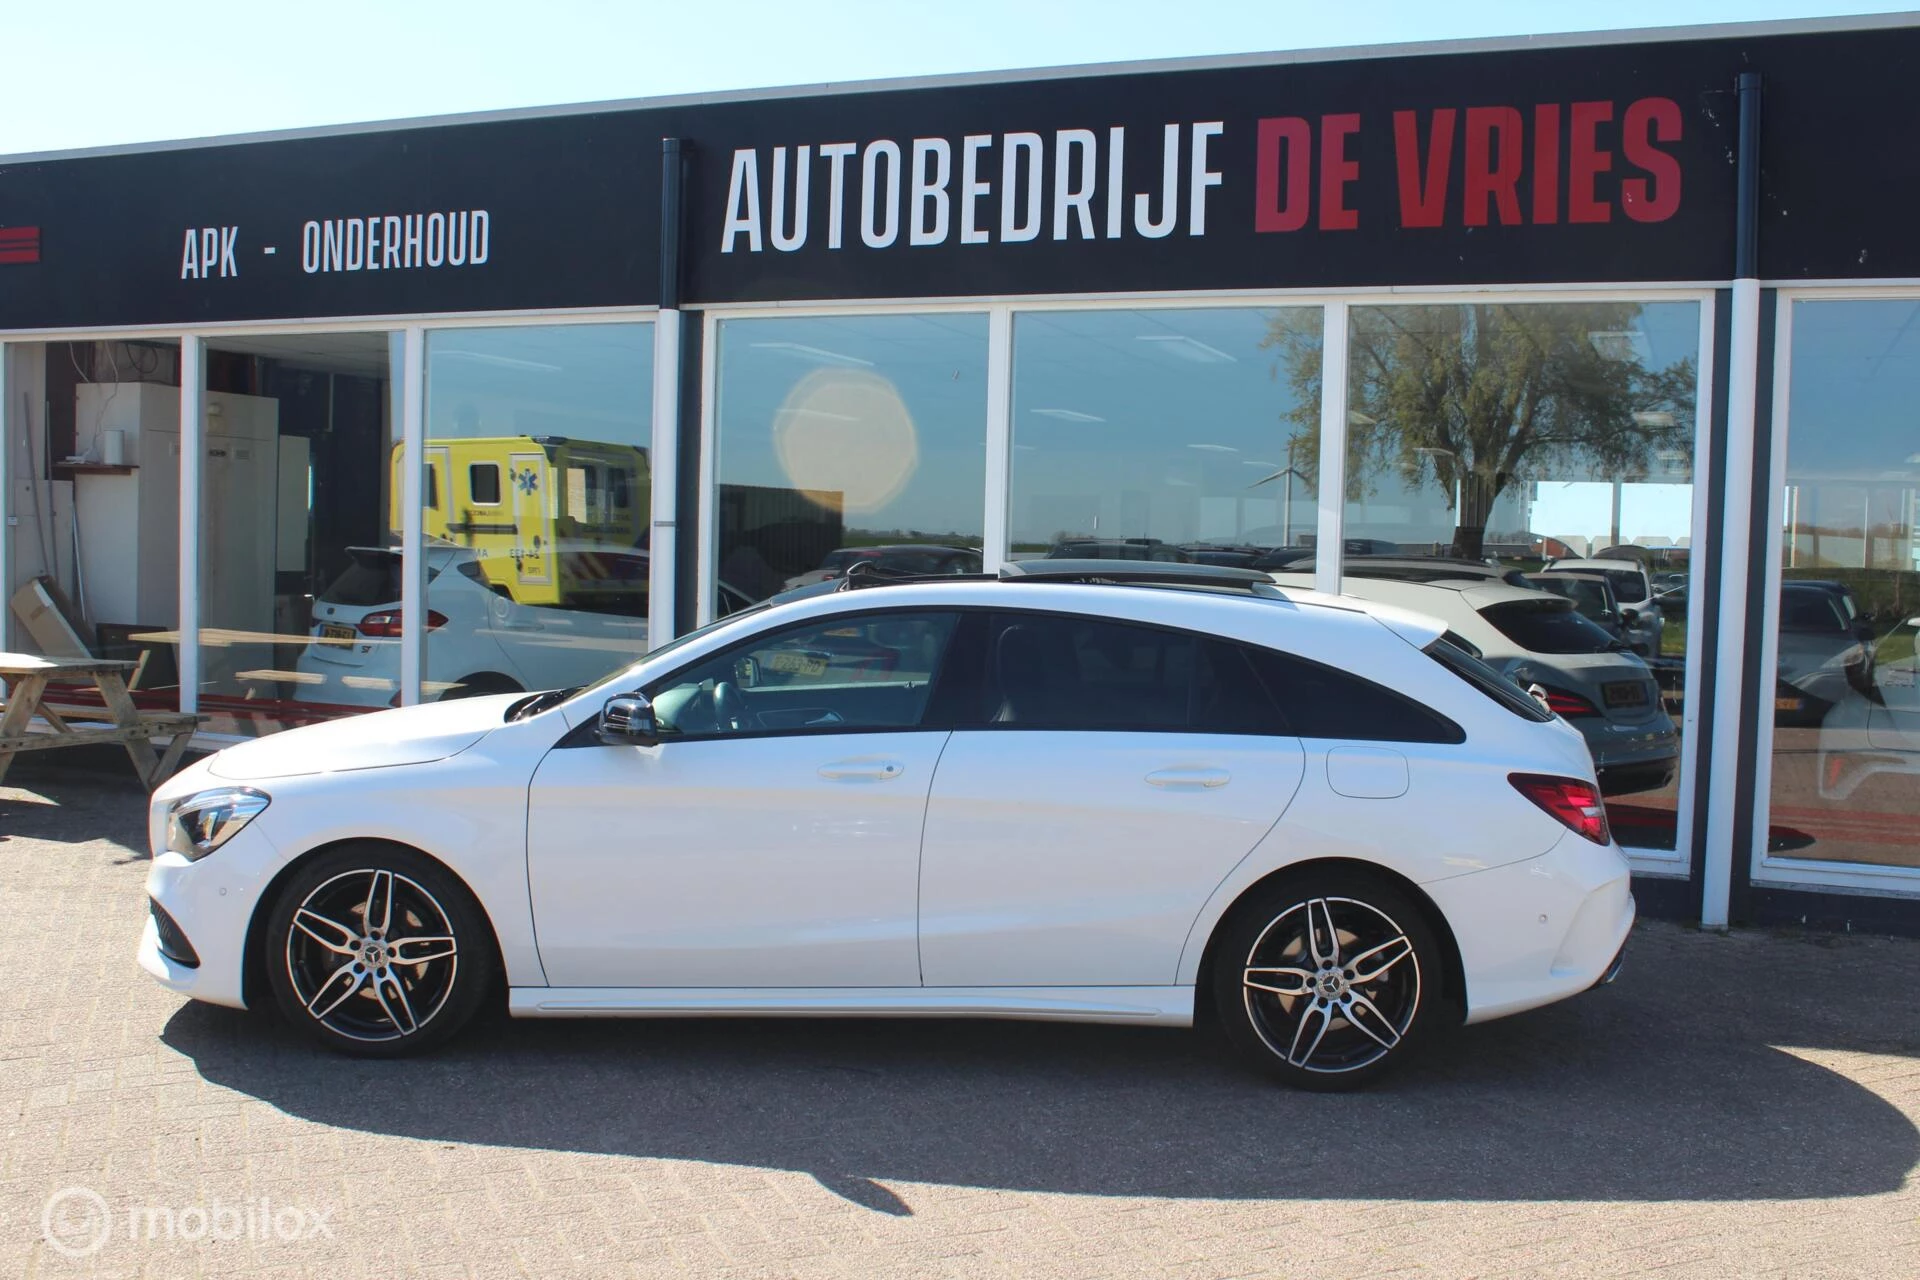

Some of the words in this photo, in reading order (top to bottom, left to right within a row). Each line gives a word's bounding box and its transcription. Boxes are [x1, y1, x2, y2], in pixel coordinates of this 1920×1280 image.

[721, 121, 1224, 253] AUTOBEDRIJF
[1255, 113, 1360, 233] DE
[1393, 97, 1682, 227] VRIES
[180, 226, 238, 280] APK
[302, 210, 489, 273] ONDERHOUD
